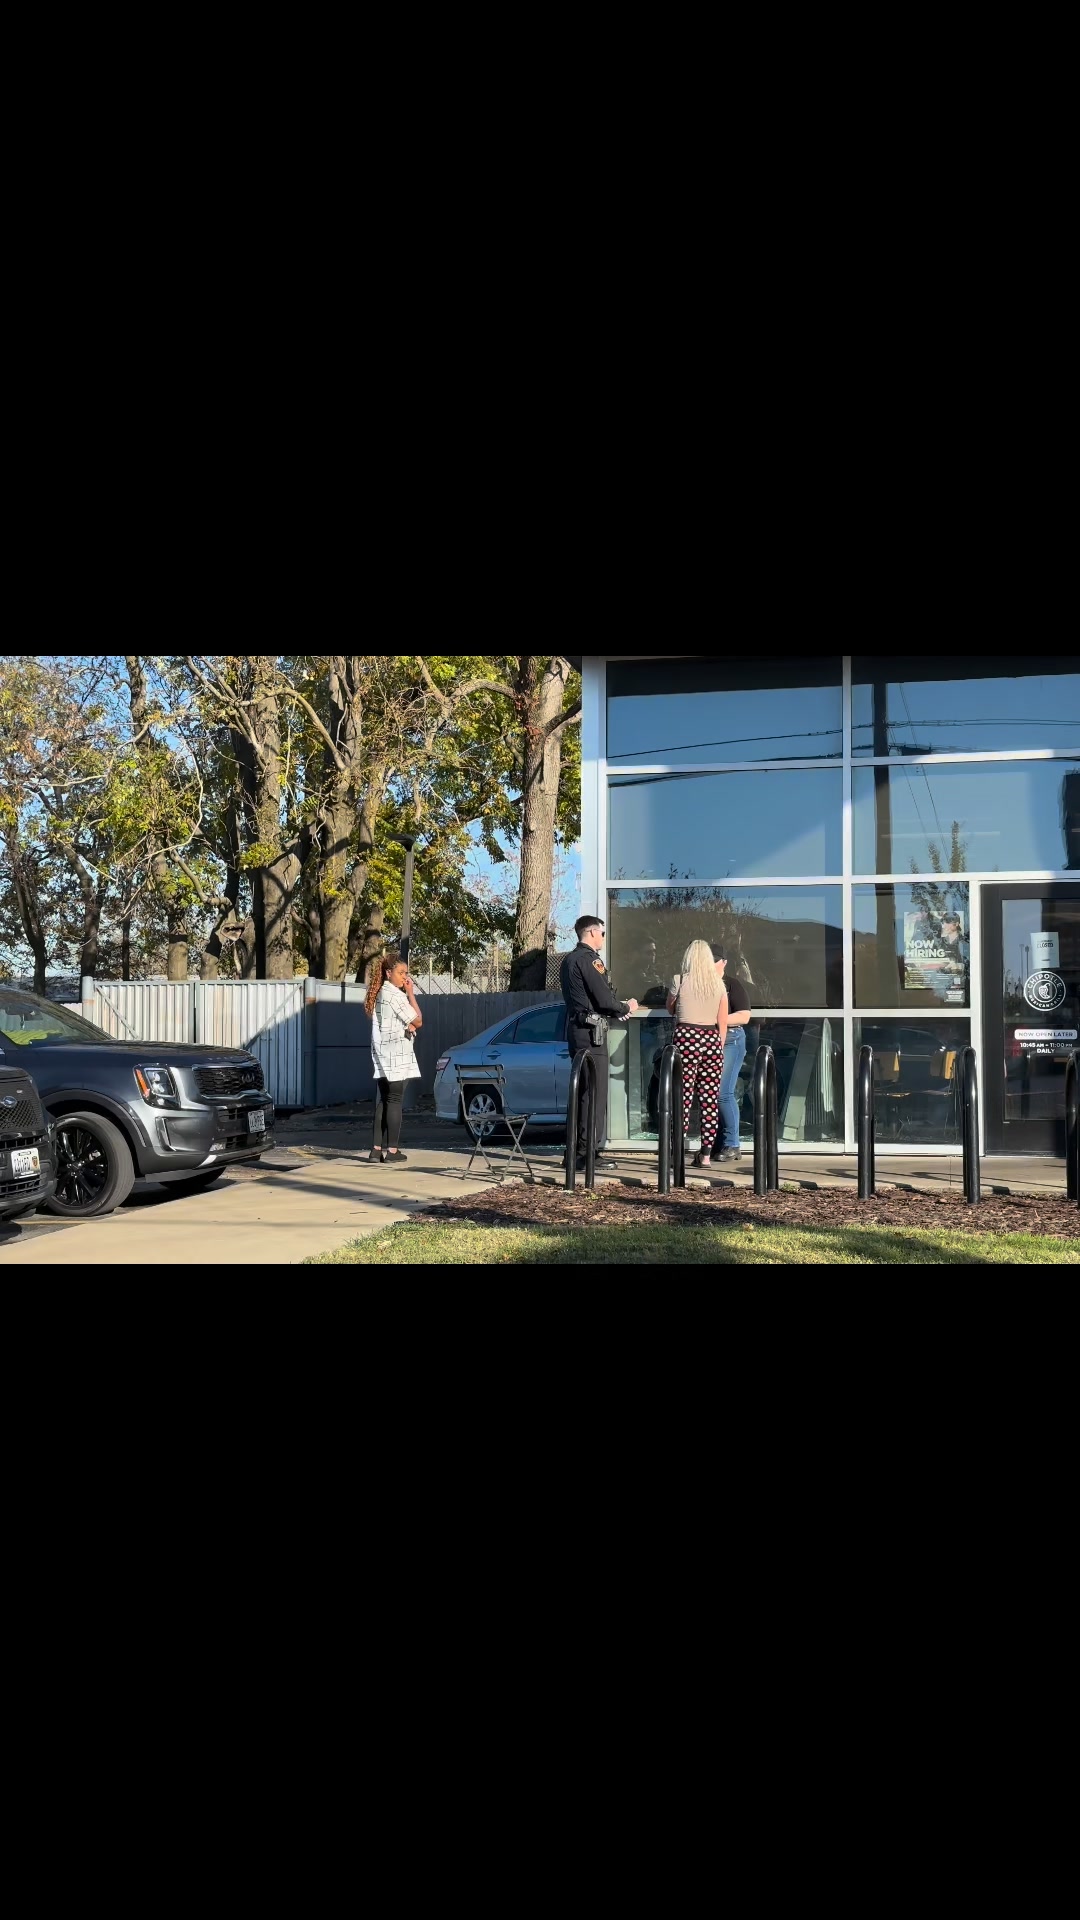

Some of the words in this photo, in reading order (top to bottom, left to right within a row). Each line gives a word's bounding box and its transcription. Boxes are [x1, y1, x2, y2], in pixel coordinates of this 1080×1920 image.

[906, 940, 935, 949] NOW
[905, 949, 946, 958] HIRING
[1028, 974, 1062, 988] CHIPOTLE
